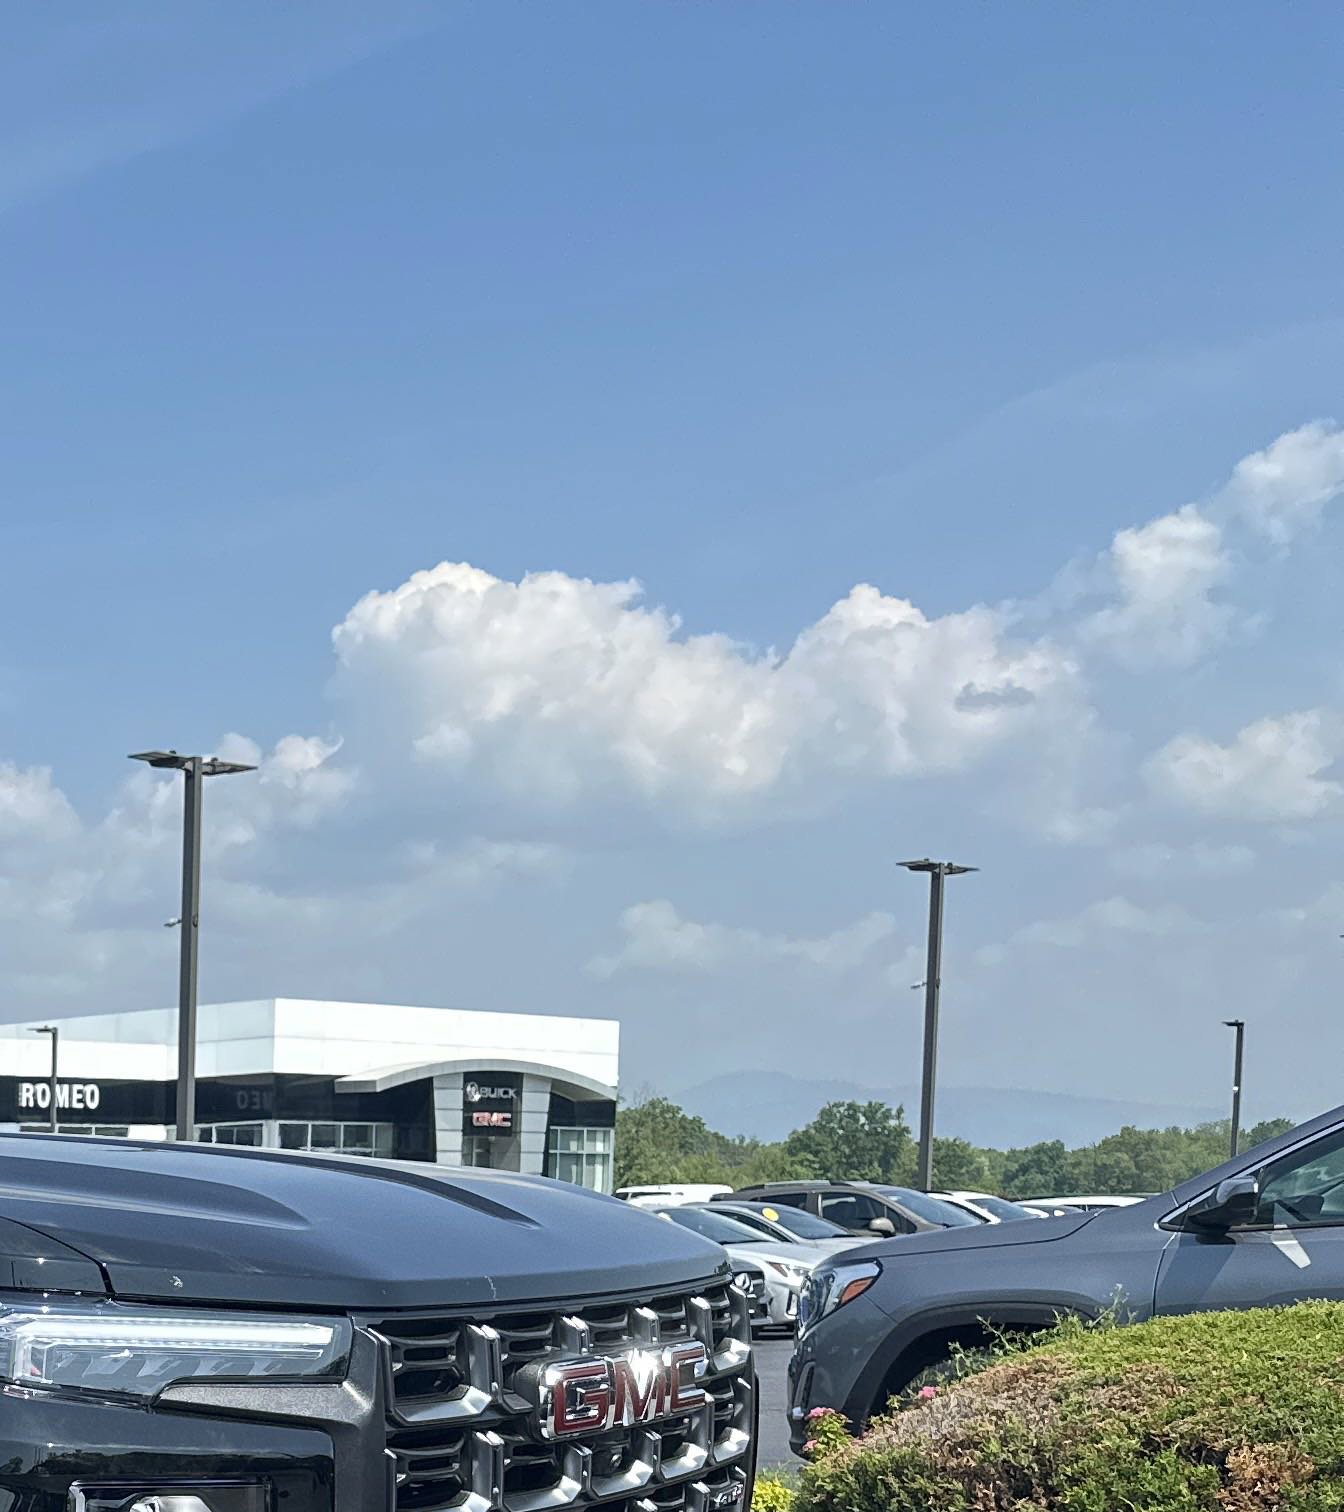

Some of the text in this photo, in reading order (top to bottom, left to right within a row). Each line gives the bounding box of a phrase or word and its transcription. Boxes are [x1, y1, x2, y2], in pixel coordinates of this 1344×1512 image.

[18, 1082, 100, 1110] ROMEO
[479, 1086, 518, 1099] BUICK
[473, 1112, 512, 1127] GMC
[544, 1341, 710, 1440] GMC
